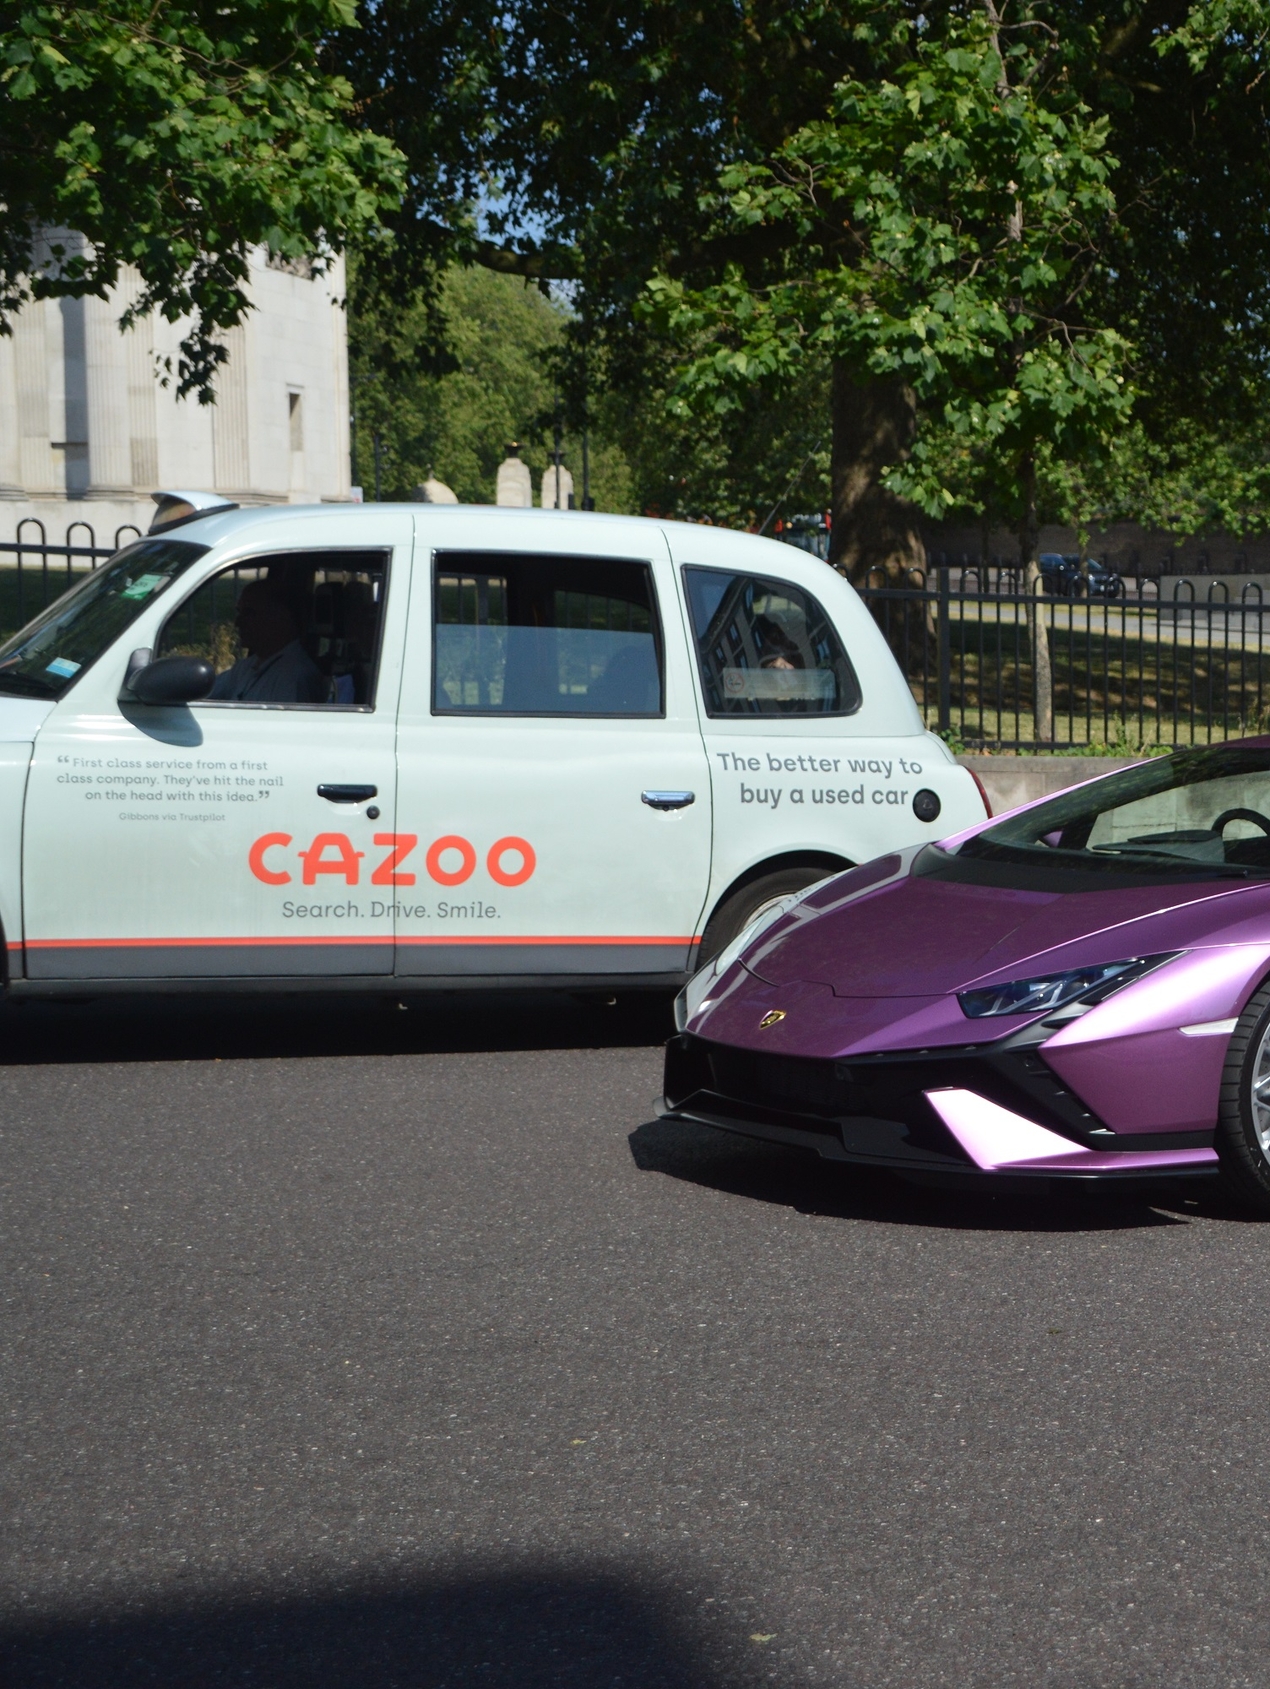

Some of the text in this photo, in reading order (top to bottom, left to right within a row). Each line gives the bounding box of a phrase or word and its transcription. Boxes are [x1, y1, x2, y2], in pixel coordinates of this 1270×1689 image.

[106, 758, 142, 769] class
[146, 759, 193, 770] service
[196, 758, 226, 771] from
[229, 761, 238, 771] a
[241, 759, 268, 771] first
[717, 752, 923, 779] The better way to
[56, 773, 93, 784] class
[96, 775, 160, 787] company.
[214, 774, 231, 786] hit
[235, 775, 256, 786] the
[259, 775, 284, 787] nail
[85, 791, 101, 801] on
[105, 789, 127, 800] the
[130, 790, 163, 801] head
[166, 790, 195, 801] with
[199, 790, 223, 801] this
[741, 783, 909, 809] buy a used car
[119, 812, 226, 824] Gibbons via Trustpilot
[248, 831, 537, 887] CAZOO
[282, 901, 501, 919] Search. Drive. Smile.
